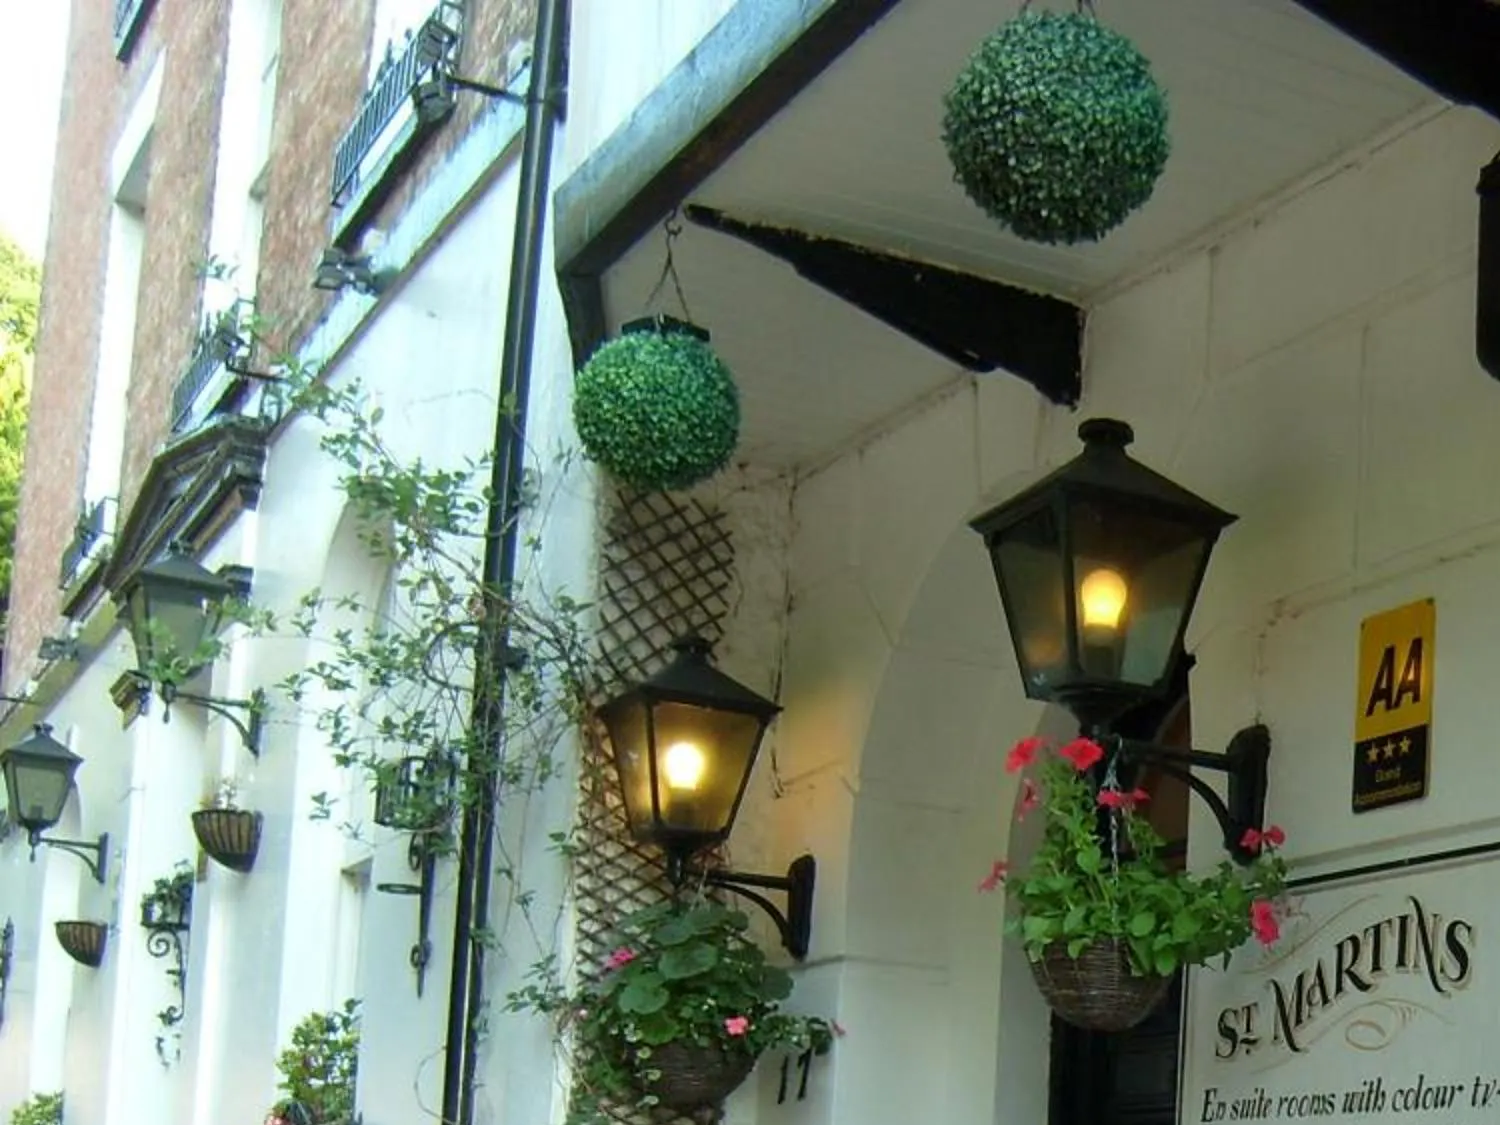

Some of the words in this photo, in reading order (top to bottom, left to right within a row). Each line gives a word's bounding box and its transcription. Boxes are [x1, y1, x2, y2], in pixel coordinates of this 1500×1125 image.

[1365, 637, 1424, 718] AA
[1268, 895, 1474, 1053] MARTINS
[1200, 1088, 1228, 1123] En
[1230, 1087, 1272, 1119] suite
[1276, 1092, 1336, 1118] rooms
[1342, 1077, 1387, 1114] with
[1391, 1074, 1465, 1112] colour
